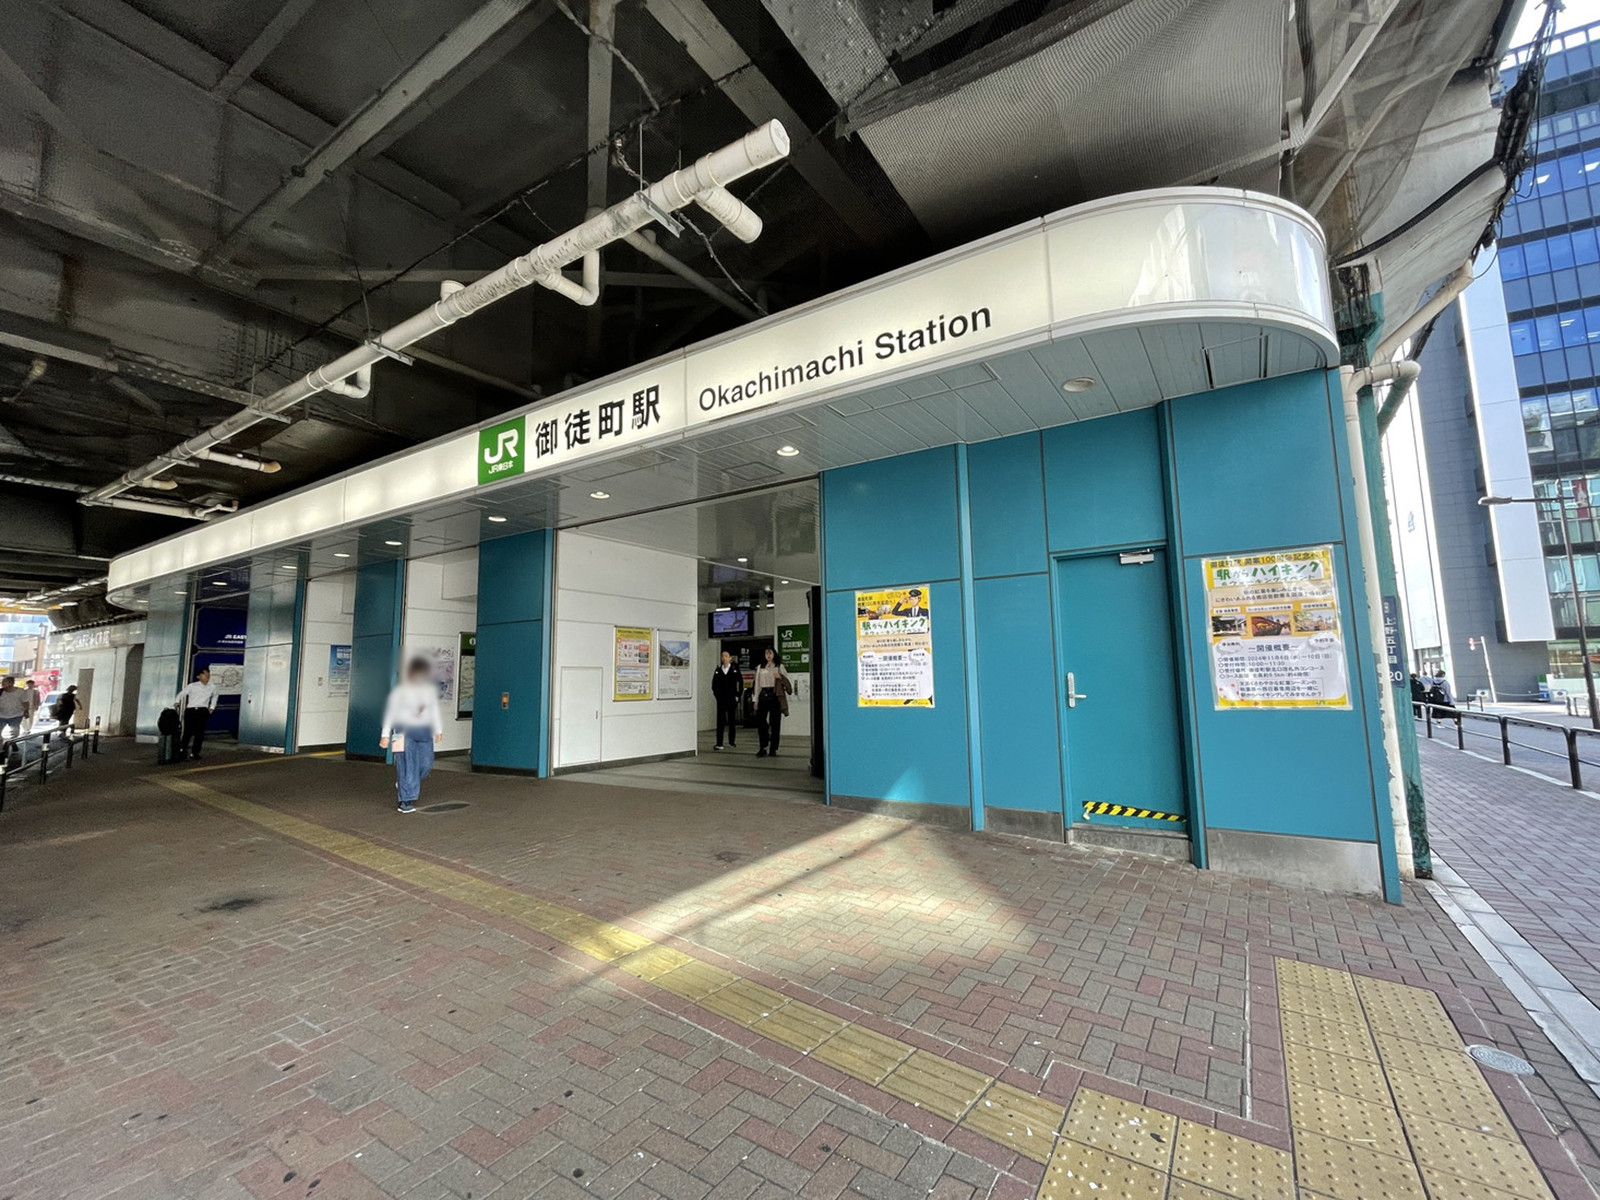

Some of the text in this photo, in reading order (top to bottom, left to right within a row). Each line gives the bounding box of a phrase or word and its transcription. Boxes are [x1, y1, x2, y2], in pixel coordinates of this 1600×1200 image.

[699, 307, 992, 411] Okachimachi Station
[535, 384, 661, 459] 御徒町駅
[484, 428, 519, 464] JR
[488, 460, 514, 474] JR東日本
[1216, 561, 1320, 580] 駅からハイキング
[781, 630, 793, 638] JR
[1384, 617, 1397, 664] 上野五丁目
